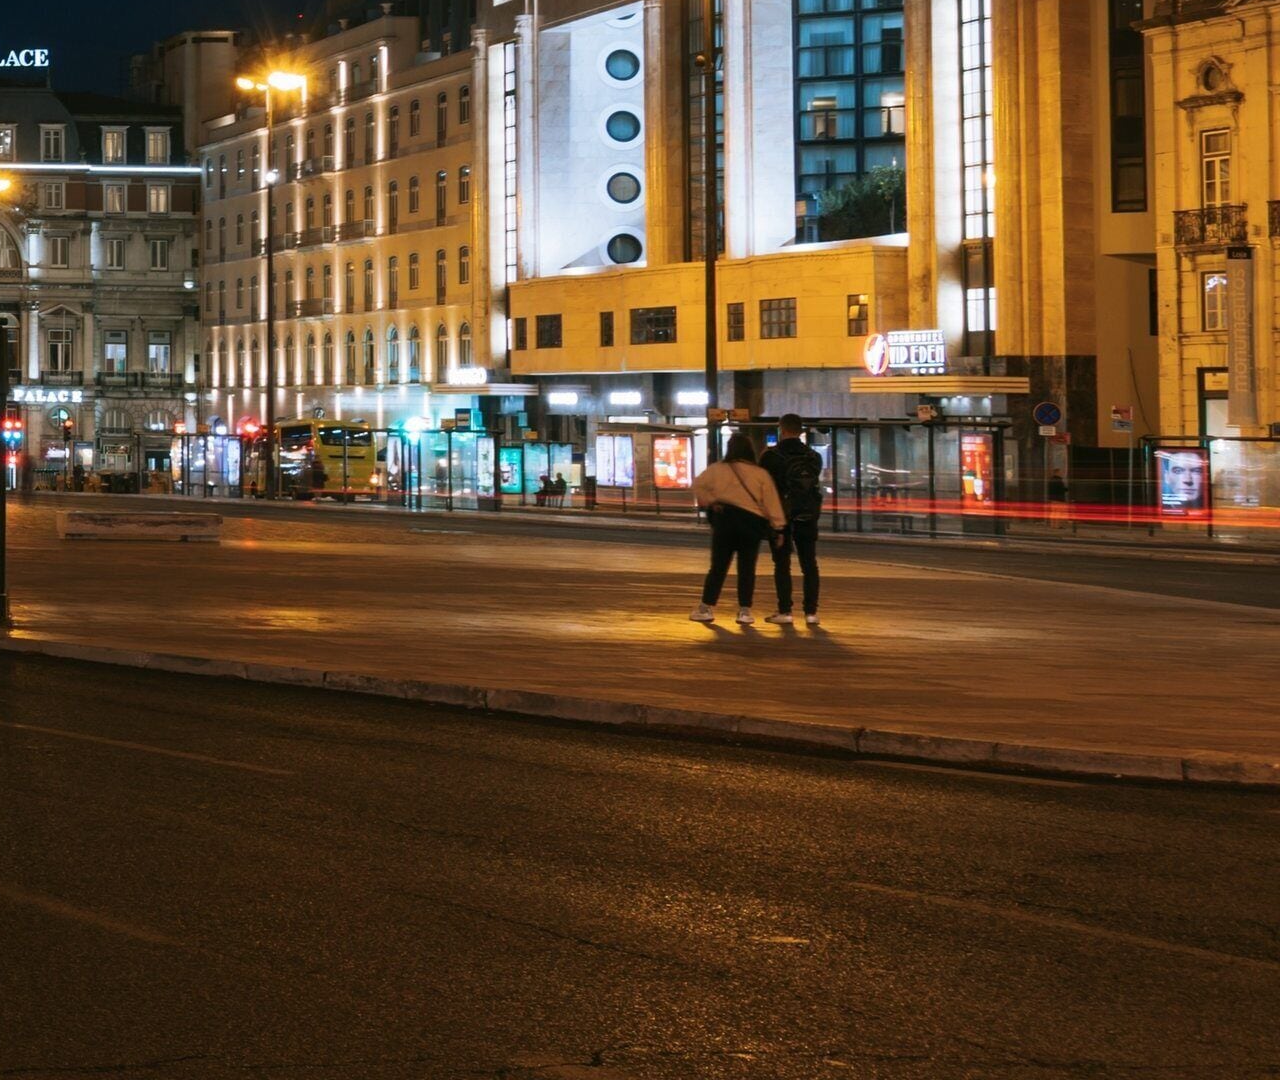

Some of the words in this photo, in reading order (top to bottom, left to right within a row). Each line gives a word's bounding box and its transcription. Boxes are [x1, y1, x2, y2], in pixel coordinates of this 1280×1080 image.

[1234, 269, 1248, 392] monumentos
[910, 344, 945, 364] EDEN
[13, 388, 83, 403] PALACE
